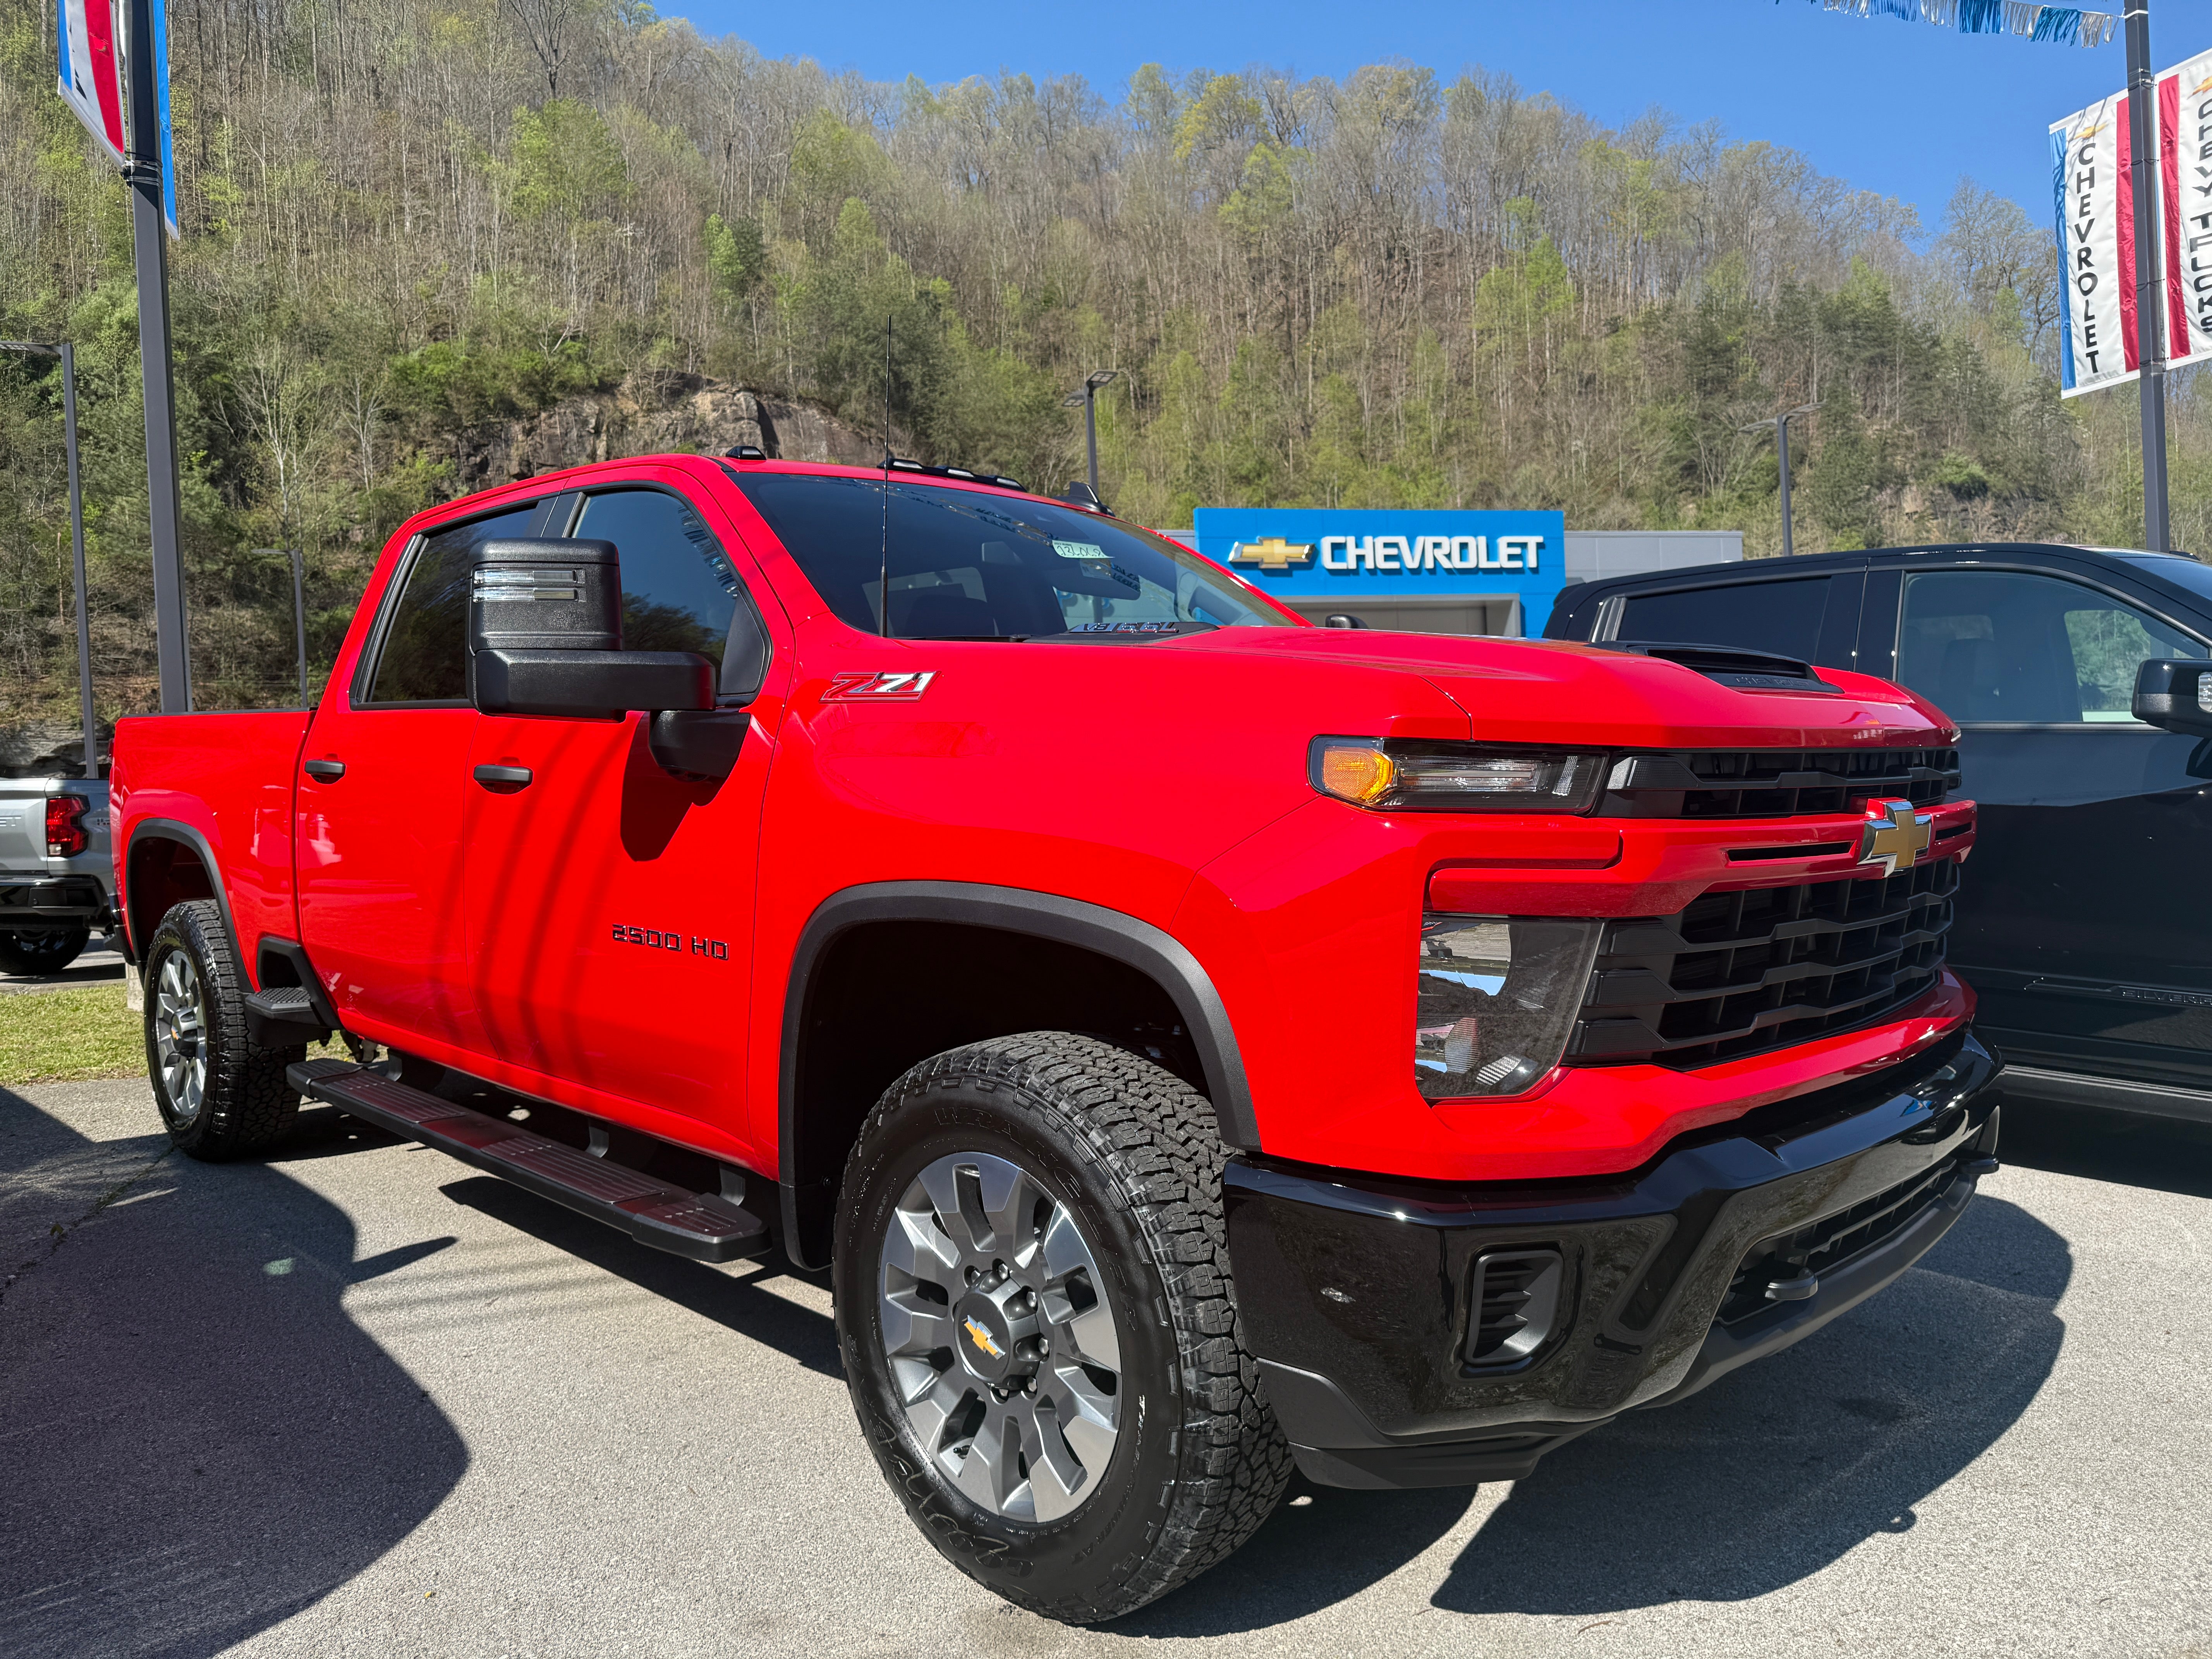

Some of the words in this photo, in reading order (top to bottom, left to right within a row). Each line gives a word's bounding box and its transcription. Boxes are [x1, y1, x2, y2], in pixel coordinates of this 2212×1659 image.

[2074, 142, 2098, 374] CHEVROLET
[1321, 534, 1544, 570] CHEVROLET
[819, 671, 941, 703] Z71
[612, 923, 682, 952] 2500
[691, 936, 730, 961] HD
